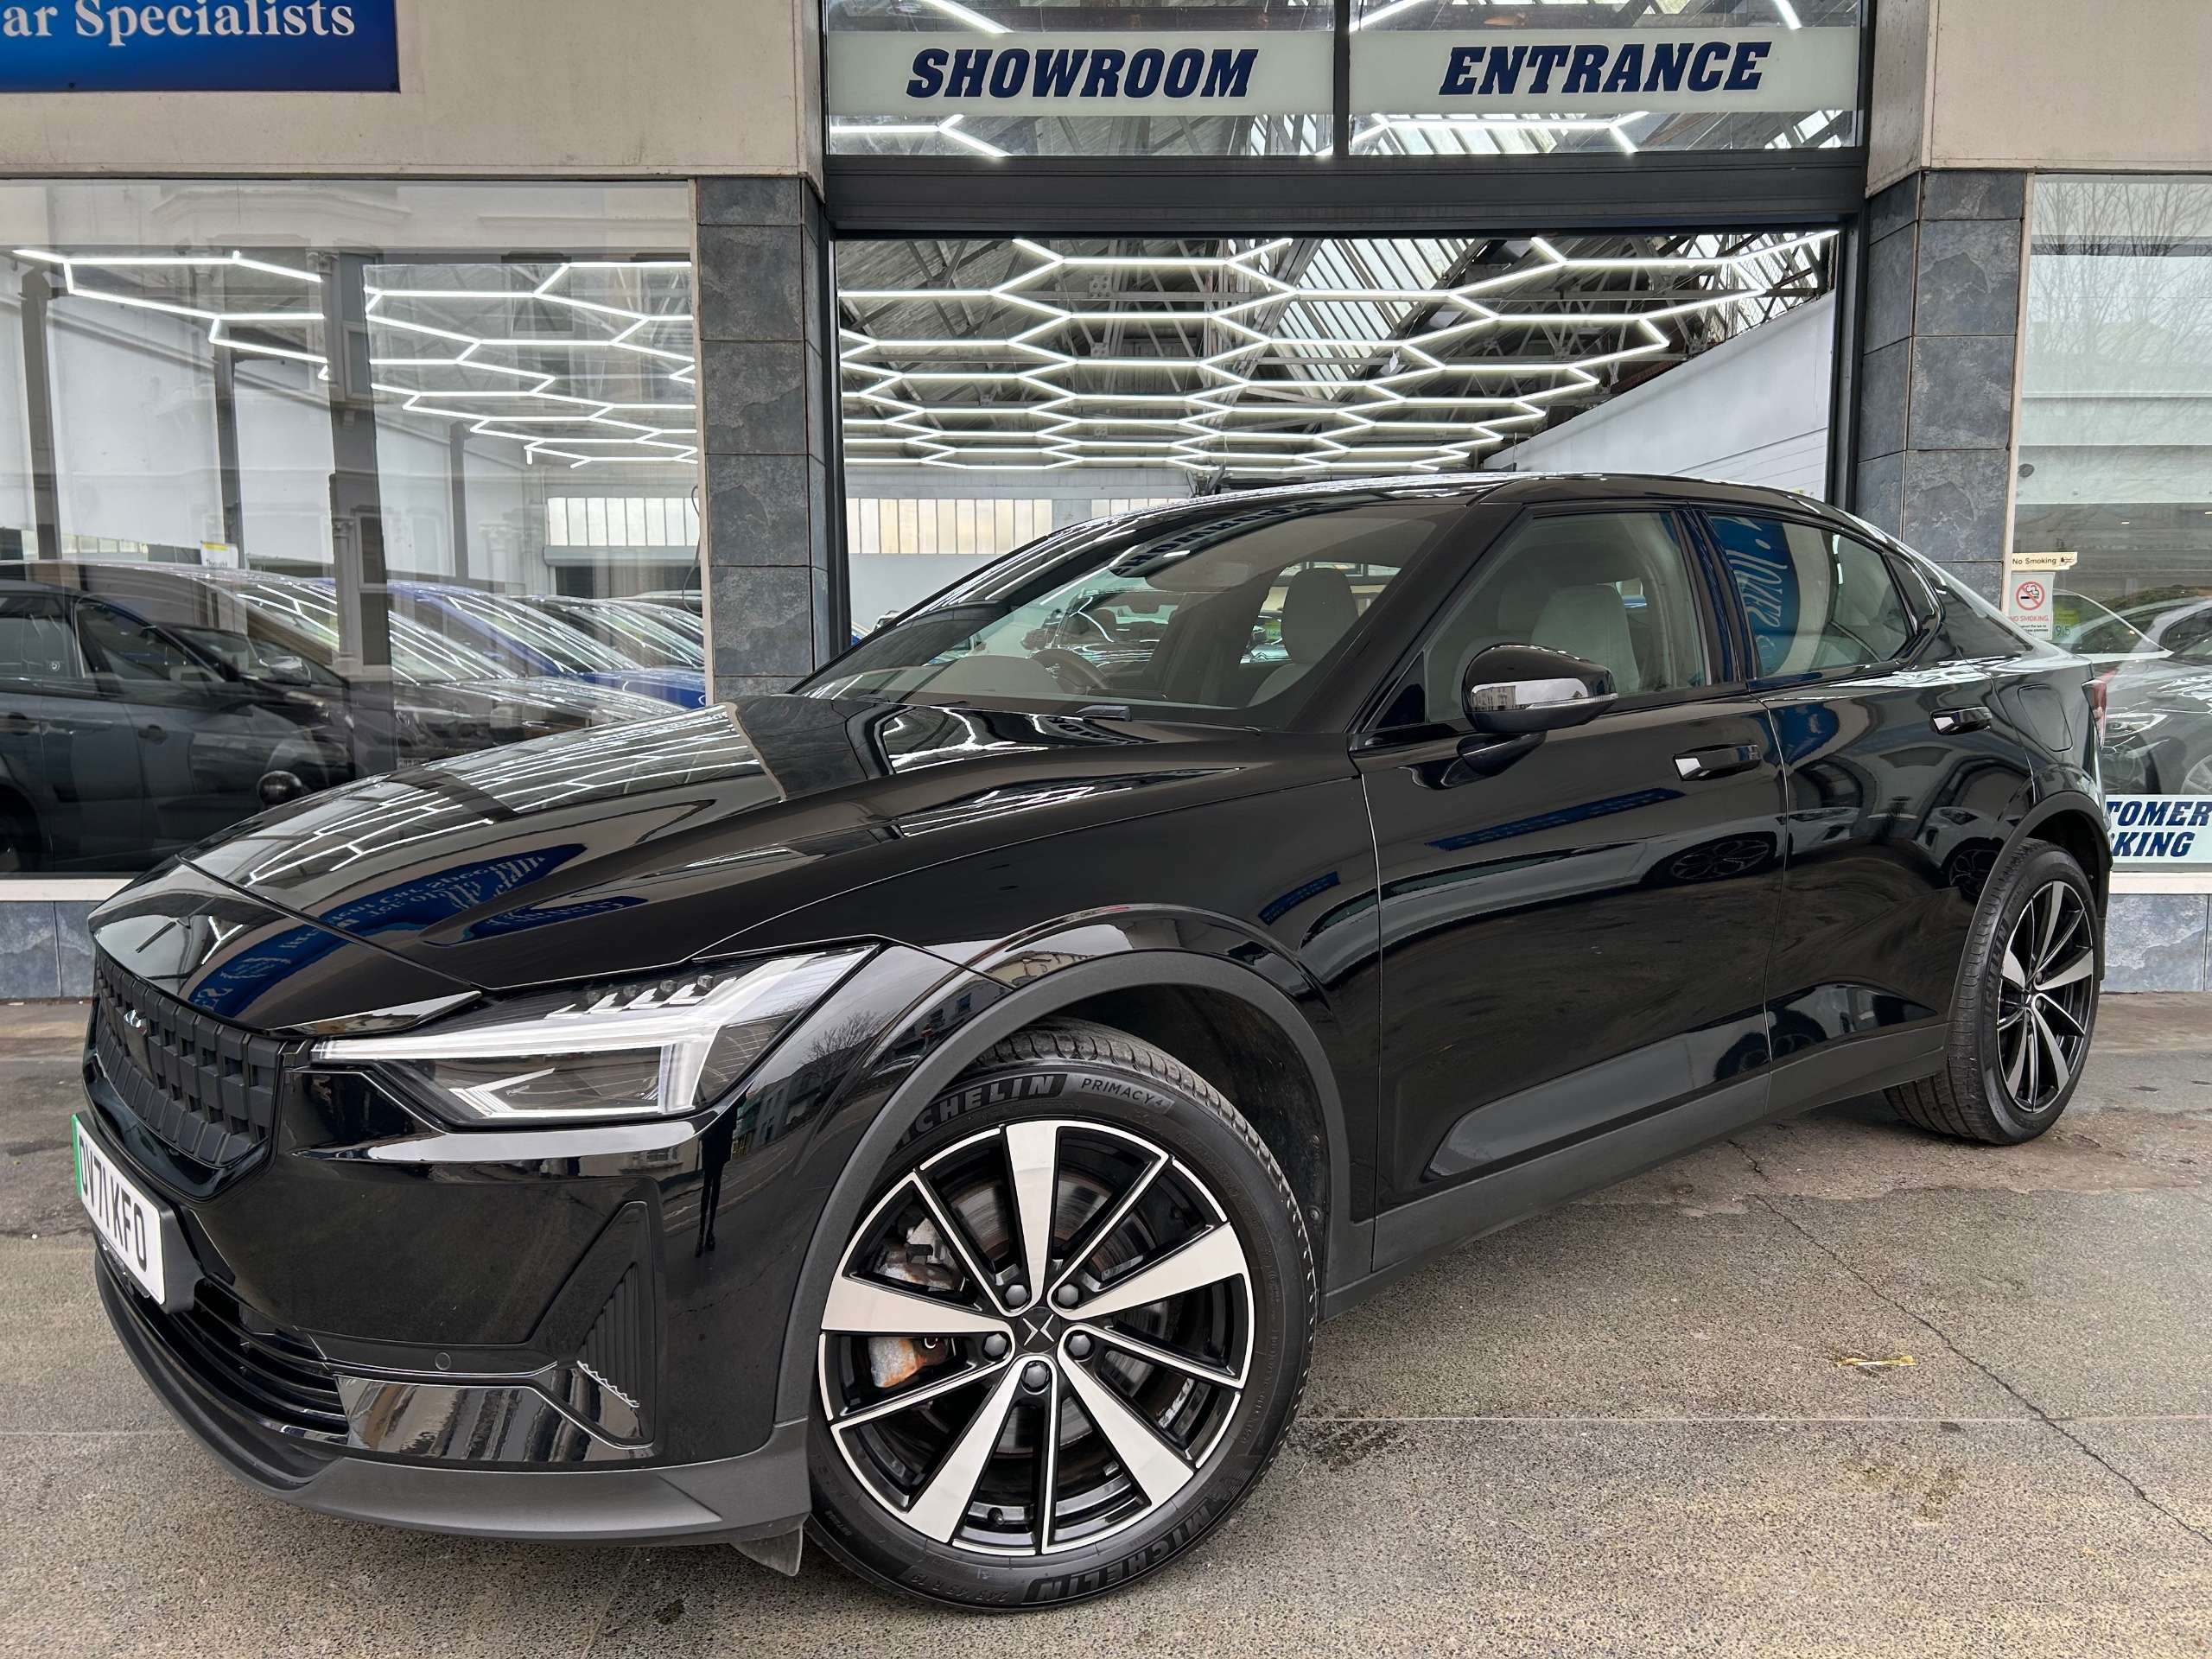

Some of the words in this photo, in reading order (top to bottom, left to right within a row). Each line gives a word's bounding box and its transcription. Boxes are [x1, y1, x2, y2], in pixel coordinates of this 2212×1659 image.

[75, 0, 356, 47] Specialists
[905, 48, 1259, 99] SHOWROOM
[1438, 41, 1773, 96] ENTRANCE
[2110, 832, 2196, 857] KING
[912, 1075, 1056, 1134] CHELIN
[1081, 1077, 1155, 1107] PRIMACY
[111, 1174, 148, 1273] KFO
[1036, 1505, 1210, 1599] MICHELIN
